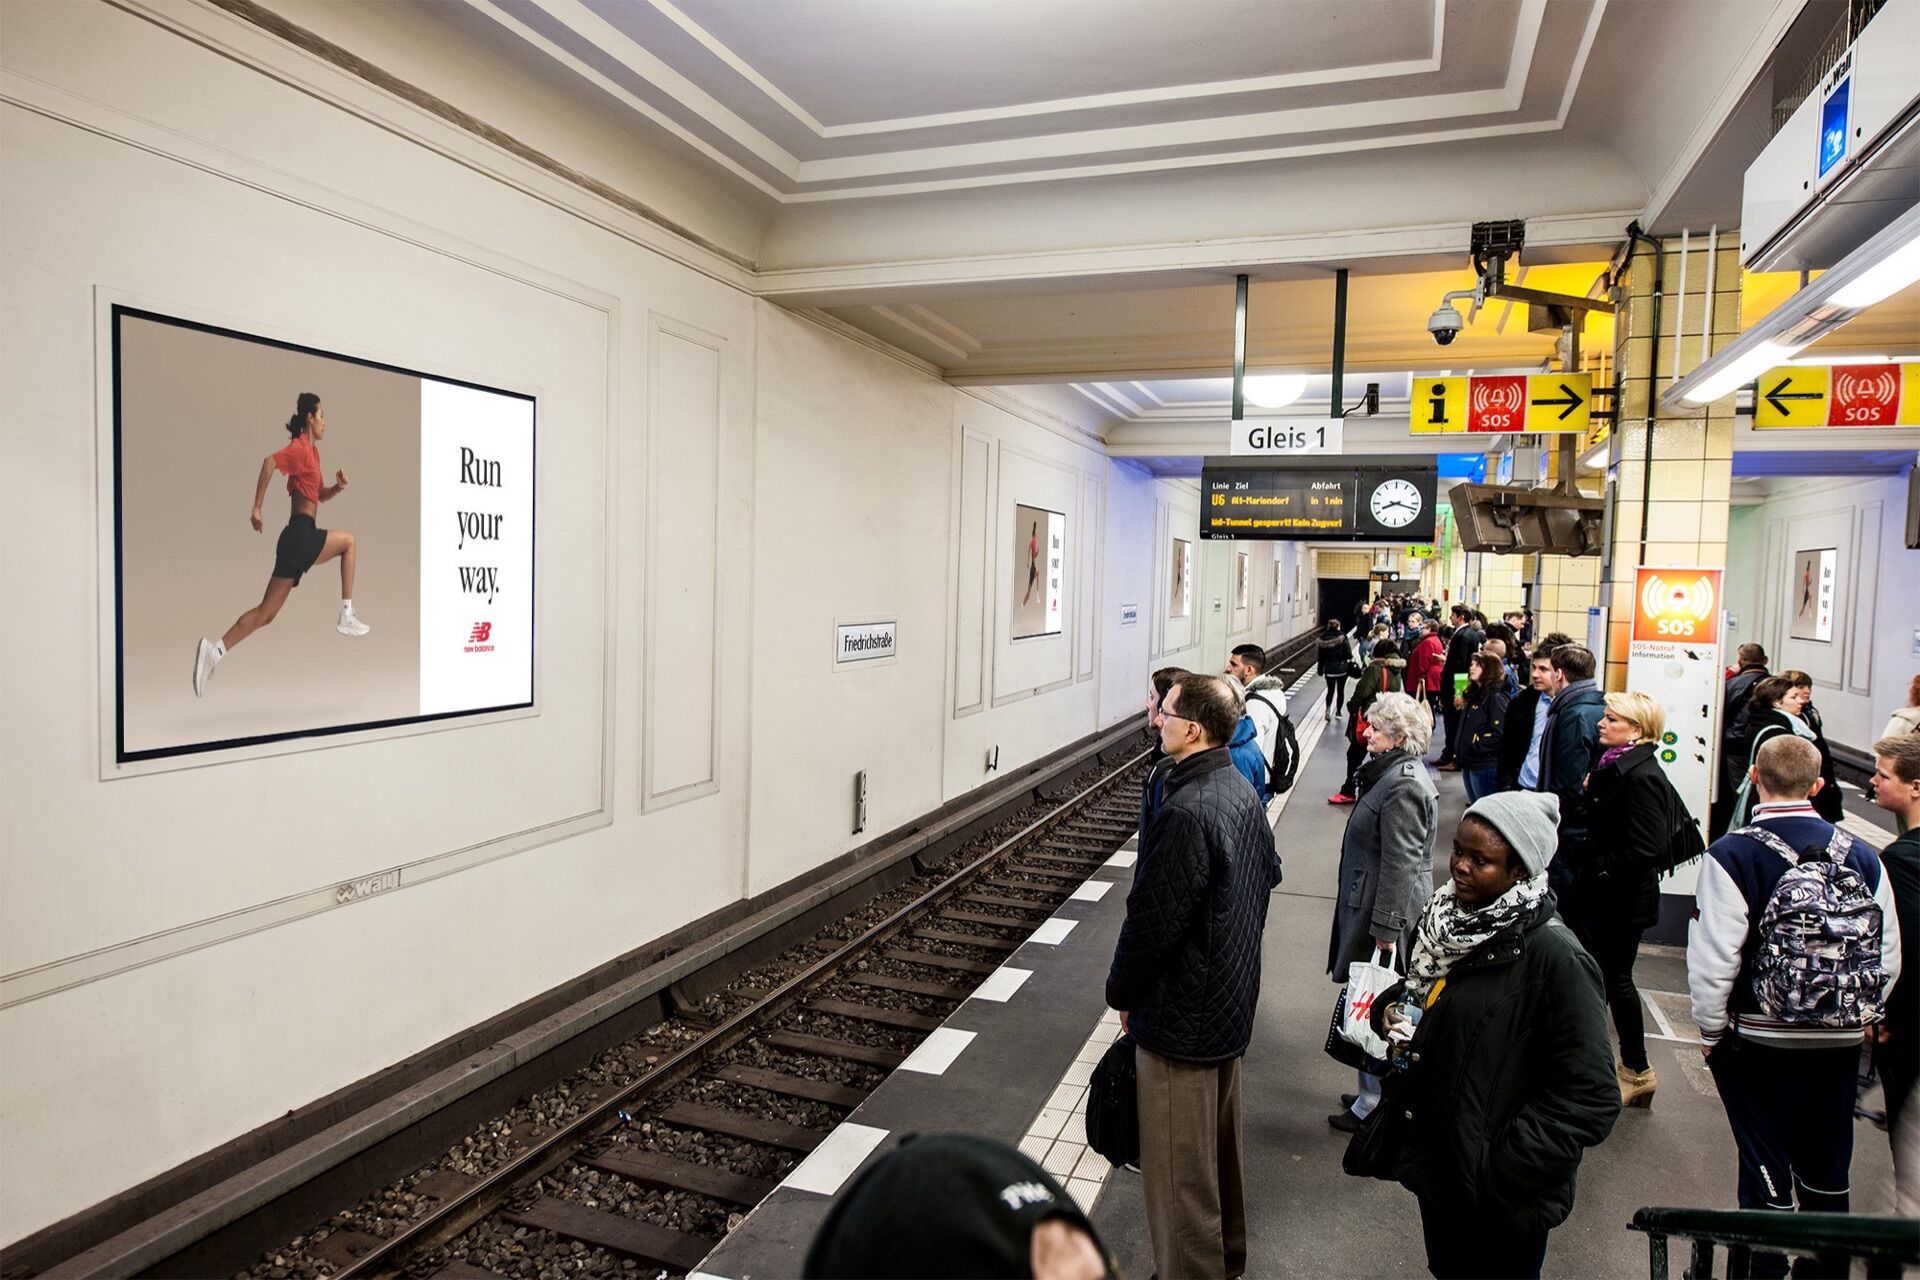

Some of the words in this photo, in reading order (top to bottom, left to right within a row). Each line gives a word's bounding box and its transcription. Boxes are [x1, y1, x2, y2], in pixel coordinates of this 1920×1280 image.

[1481, 414, 1511, 427] SOS
[1845, 407, 1881, 422] SOS
[1248, 426, 1306, 449] Gleis
[1316, 426, 1326, 448] 1
[459, 446, 502, 488] Run
[1212, 482, 1230, 490] Linie
[1235, 482, 1248, 490] Ziel
[1311, 481, 1341, 490] Abfahrt
[1211, 493, 1226, 506] U6
[457, 510, 503, 550] your
[458, 565, 500, 605] way.
[1657, 619, 1695, 636] SOS
[474, 645, 495, 653] balance
[844, 632, 893, 653] Friedrichstraße
[1632, 643, 1675, 651] SOS-Notruf
[1632, 651, 1675, 660] Information
[354, 870, 394, 897] Wall
